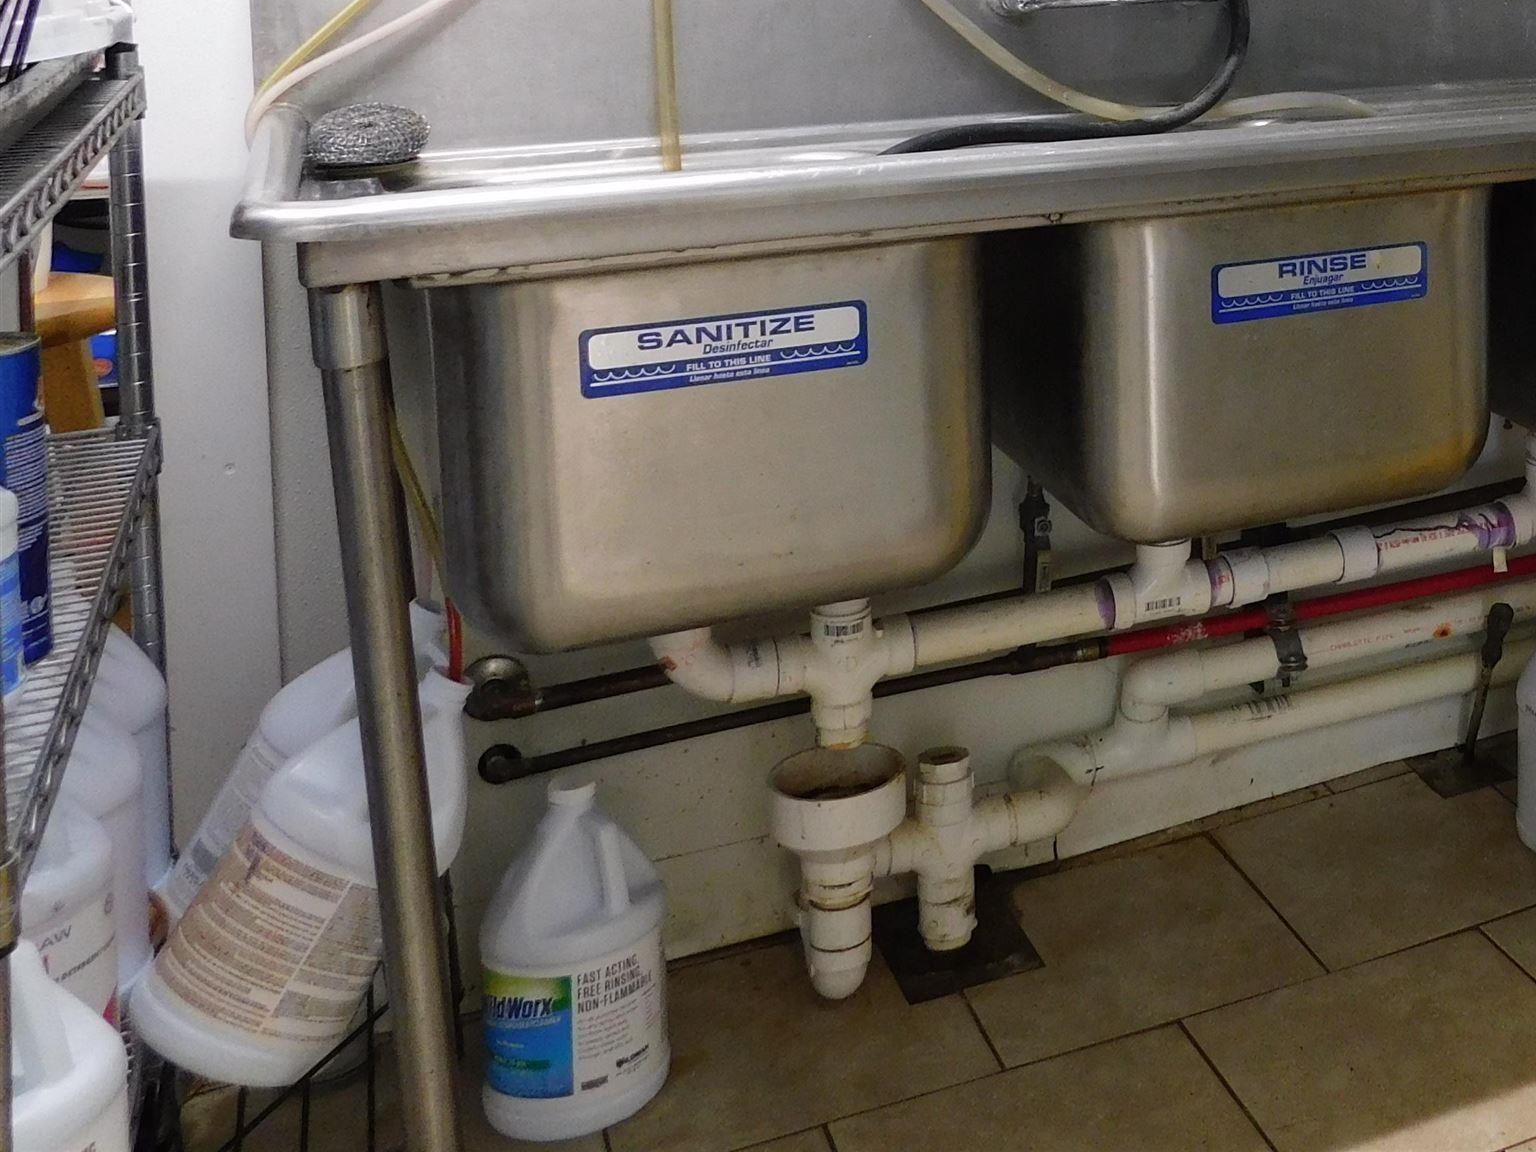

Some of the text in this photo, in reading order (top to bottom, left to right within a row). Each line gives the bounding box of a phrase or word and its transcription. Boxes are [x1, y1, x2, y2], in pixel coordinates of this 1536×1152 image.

[1277, 253, 1367, 279] RINSE
[1302, 272, 1344, 287] Enjuagar
[636, 313, 816, 351] SANITIZE
[702, 337, 774, 356] Desinfectar
[686, 353, 772, 372] FILL TO THIS LINE
[576, 953, 639, 987] FAST ACTING
[576, 982, 602, 1000] FREE
